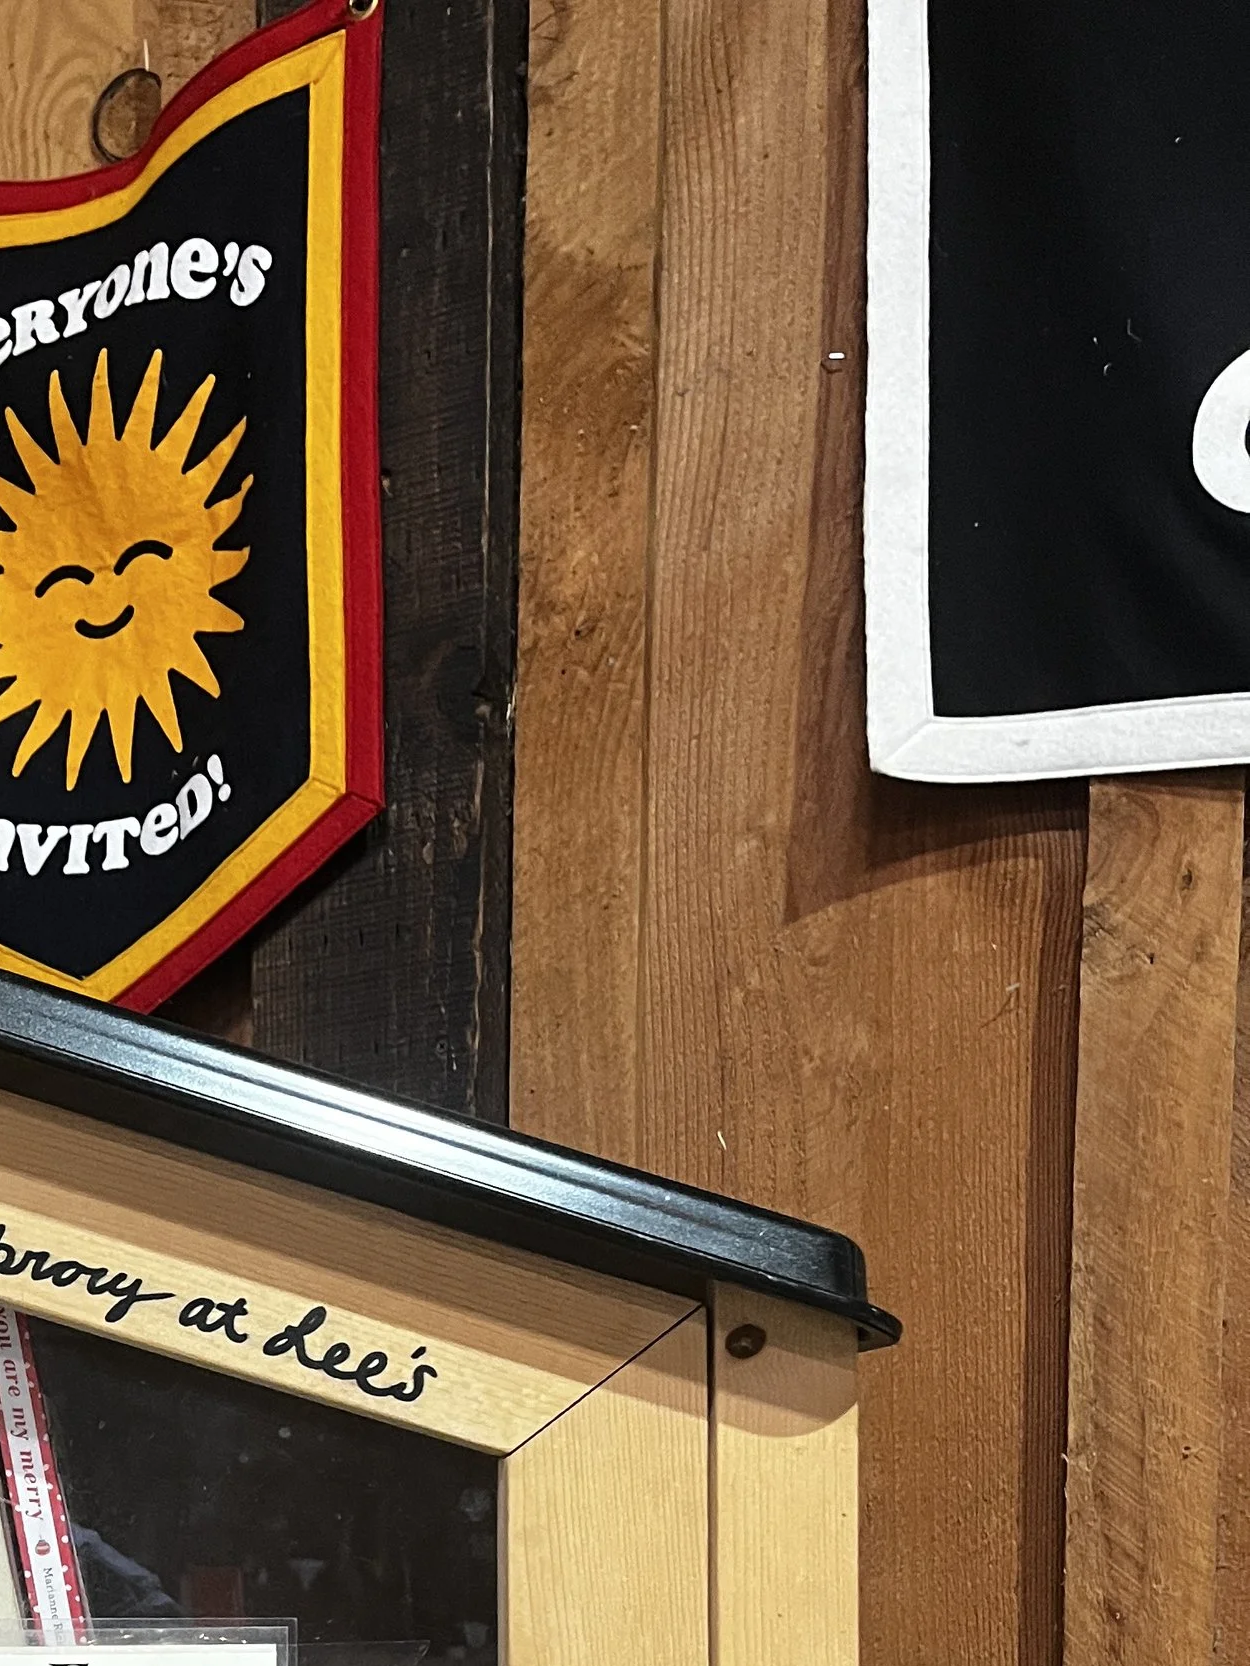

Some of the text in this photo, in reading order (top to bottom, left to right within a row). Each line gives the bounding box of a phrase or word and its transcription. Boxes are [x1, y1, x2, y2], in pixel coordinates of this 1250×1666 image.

[180, 1292, 248, 1344] at
[263, 1306, 438, 1404] Lee's
[2, 1358, 21, 1397] are
[10, 1406, 29, 1441] my
[19, 1449, 44, 1521] merry
[43, 1566, 59, 1621] Marianne
